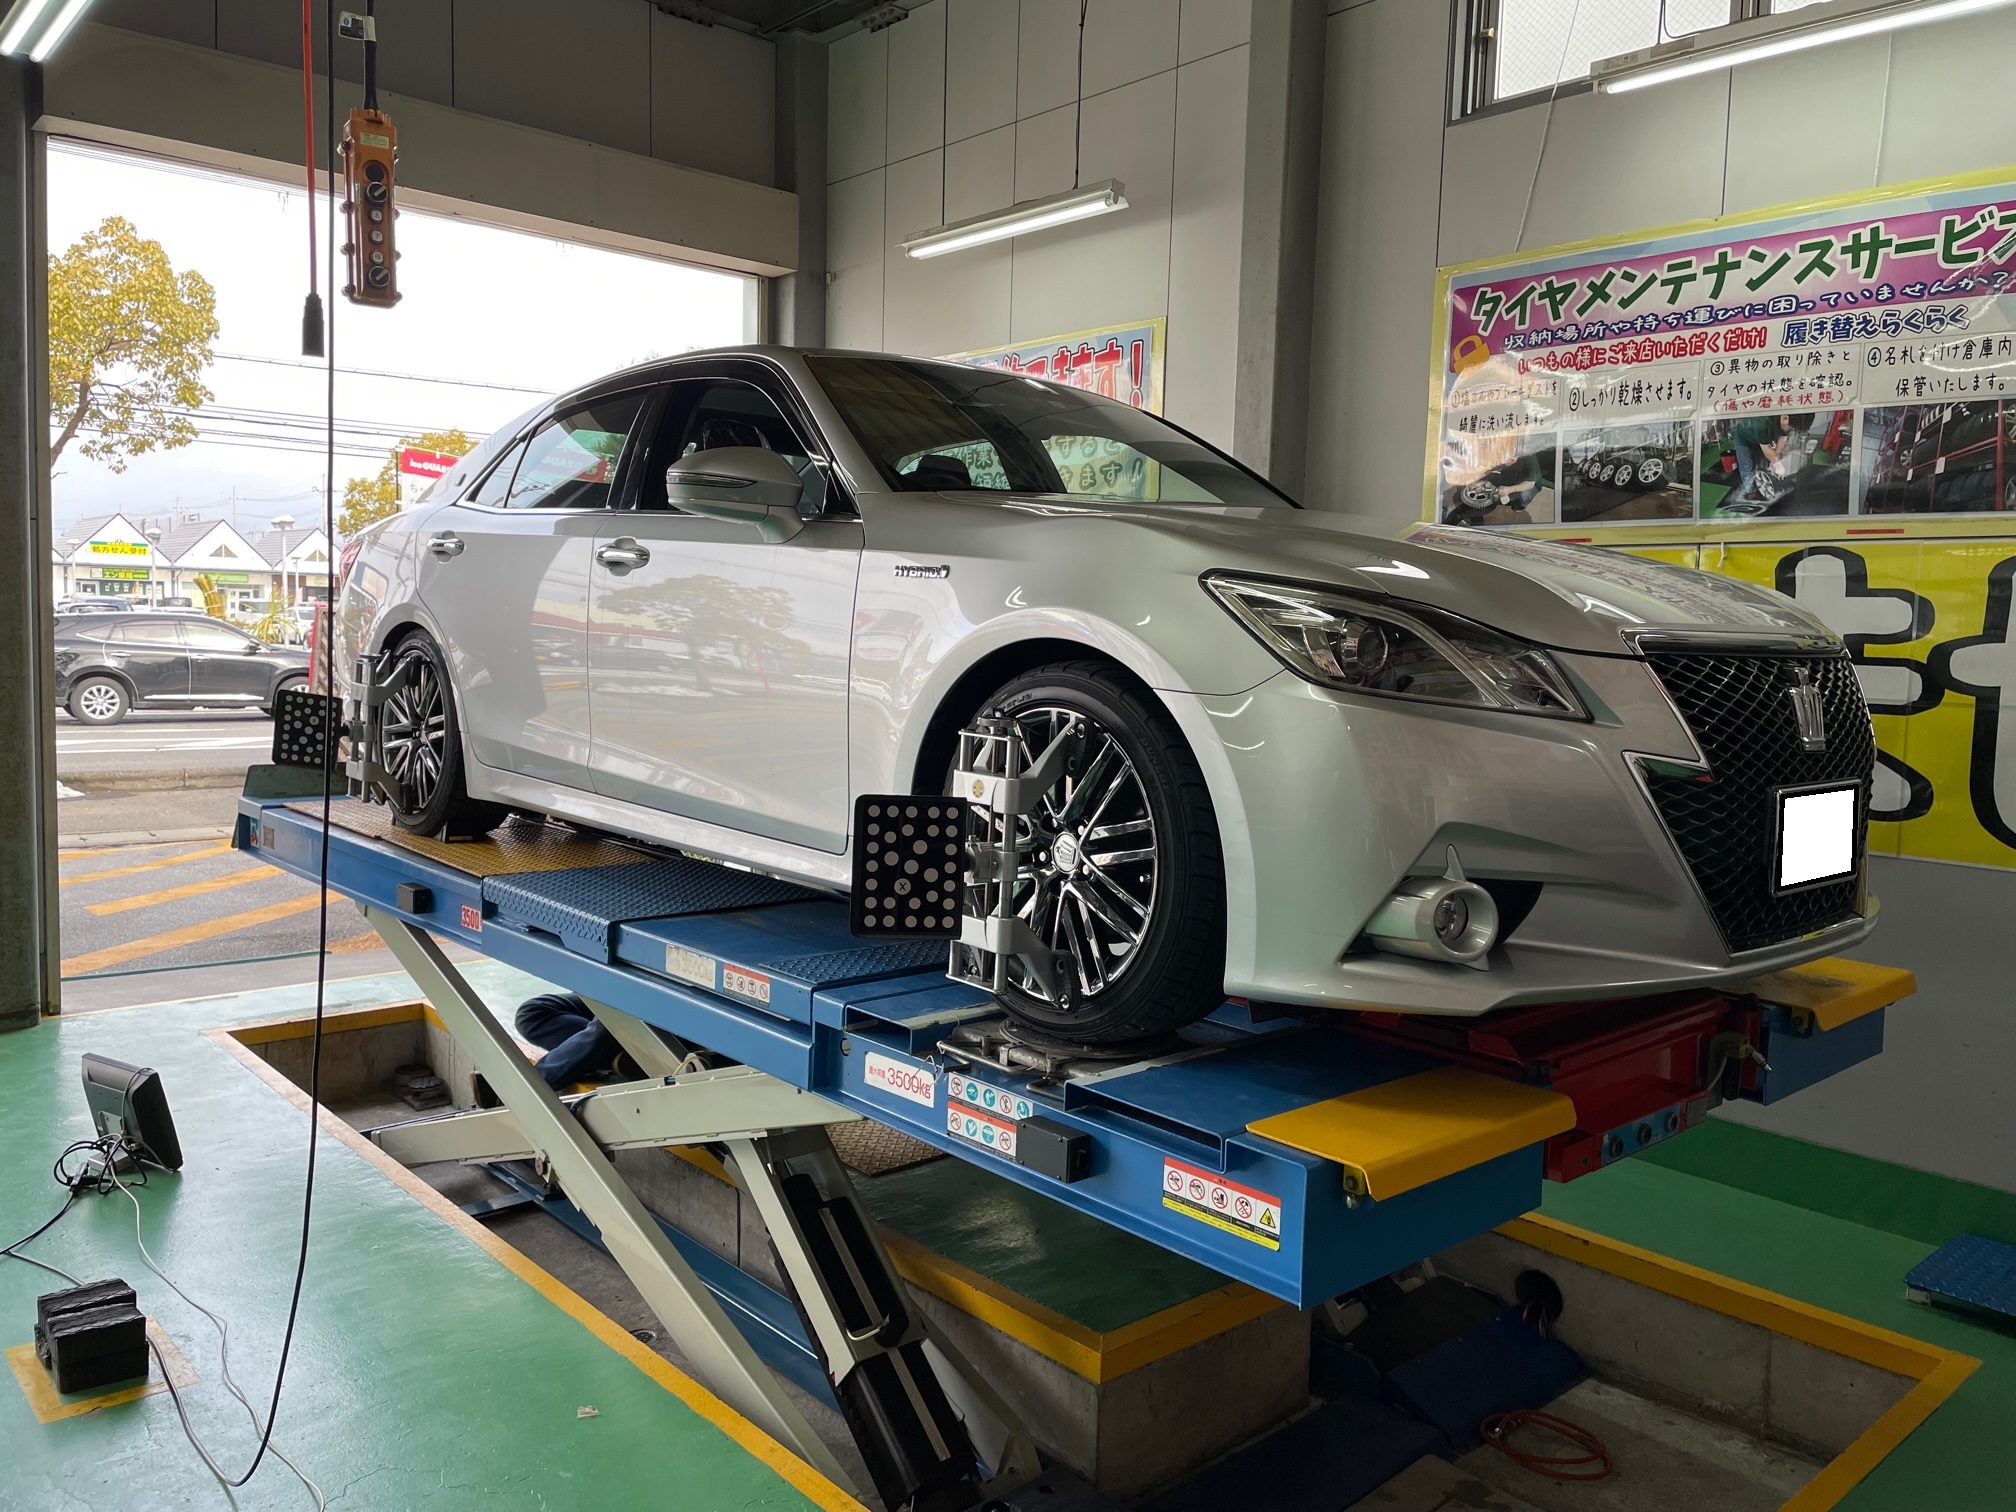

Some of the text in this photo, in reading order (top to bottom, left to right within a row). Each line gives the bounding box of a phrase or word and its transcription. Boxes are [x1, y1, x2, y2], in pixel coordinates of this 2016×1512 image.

[1782, 304, 1971, 348] 履き替えらくらく
[1895, 372, 2006, 398] 保管いたします。
[92, 545, 147, 555] 処方せん受付
[893, 564, 938, 578] HYBRID
[461, 906, 480, 930] 3500
[887, 1066, 932, 1100] 3500kg
